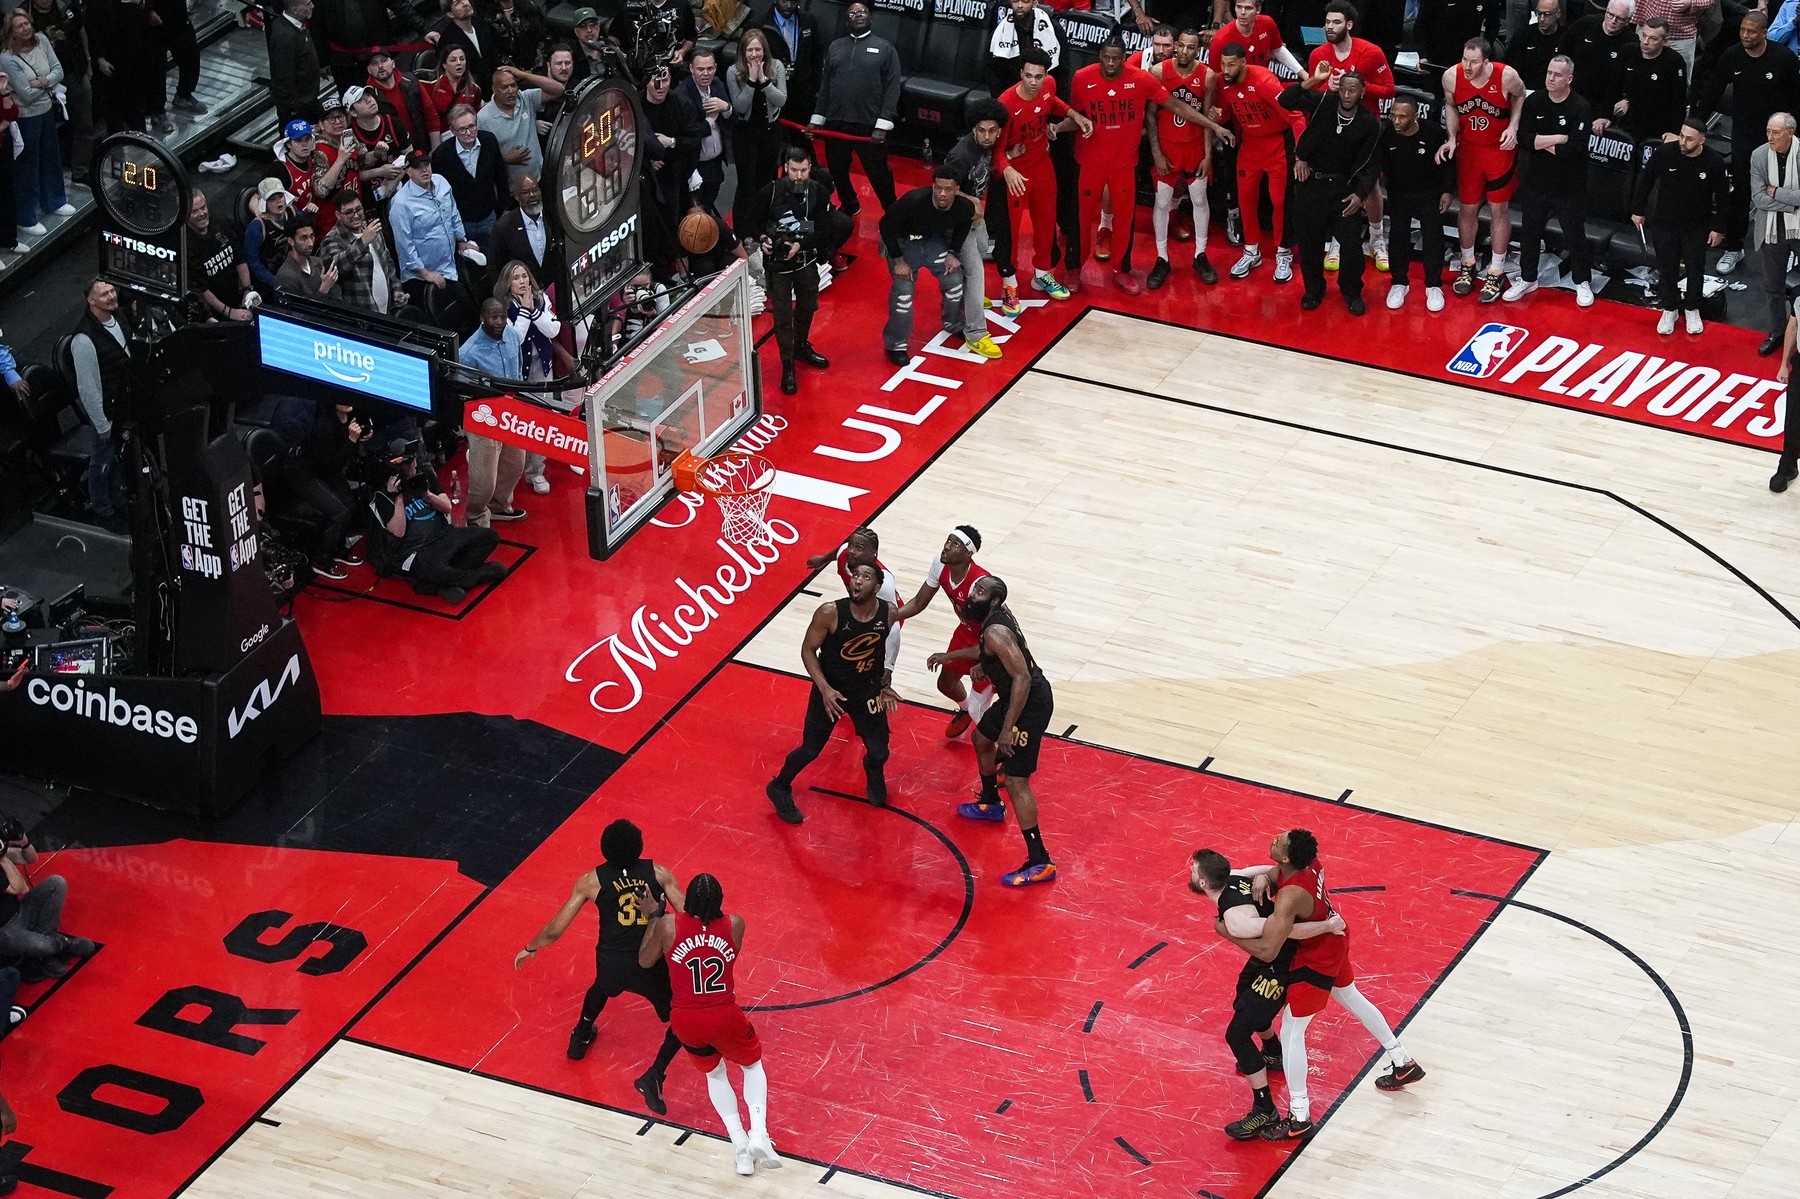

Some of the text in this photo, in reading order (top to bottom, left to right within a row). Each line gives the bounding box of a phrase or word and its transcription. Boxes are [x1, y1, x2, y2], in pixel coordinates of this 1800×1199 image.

[1066, 20, 1111, 43] PLAYOFFS
[583, 110, 613, 158] 2.0
[1469, 115, 1490, 132] 19
[1588, 134, 1633, 162] PLAYOFFS
[124, 161, 156, 191] 2.0
[123, 236, 177, 262] TISSOT
[588, 213, 638, 264] TISSOT
[313, 340, 376, 371] prime
[1452, 360, 1479, 373] NBA
[1499, 336, 1788, 438] PLAYOFFS
[182, 496, 208, 523] GET
[228, 481, 246, 517] GET
[184, 520, 213, 548] THE
[231, 506, 250, 540] THE
[195, 547, 222, 580] App
[239, 534, 258, 565] App
[240, 623, 269, 652] Google
[27, 678, 198, 743] coinbase
[671, 934, 735, 964] MURRAY-BOYLES
[685, 956, 726, 994] 12
[1251, 974, 1285, 1000] CAVS
